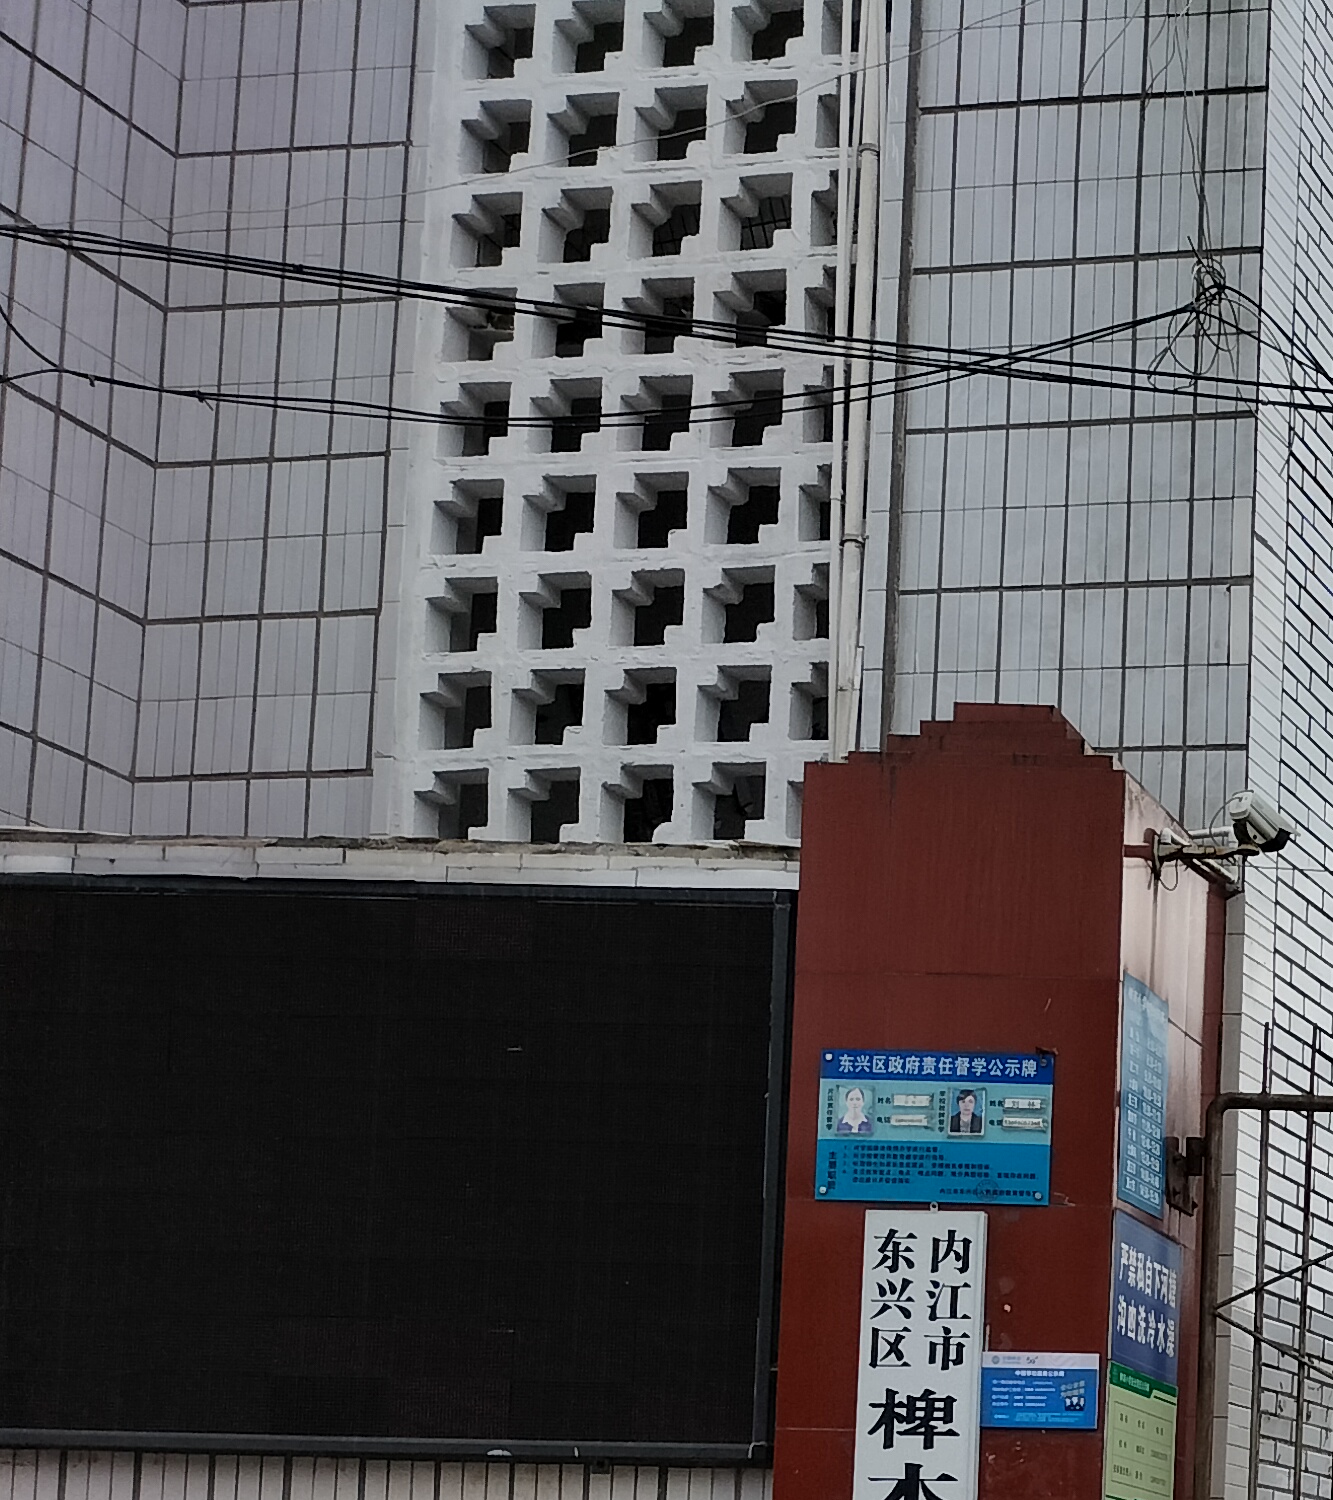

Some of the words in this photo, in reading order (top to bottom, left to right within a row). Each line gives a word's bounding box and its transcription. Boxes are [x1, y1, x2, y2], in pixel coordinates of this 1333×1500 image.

[838, 1053, 1039, 1078] 东兴区政府责任督学公示牌
[867, 1228, 919, 1371] 东兴区
[924, 1229, 973, 1372] 内江市
